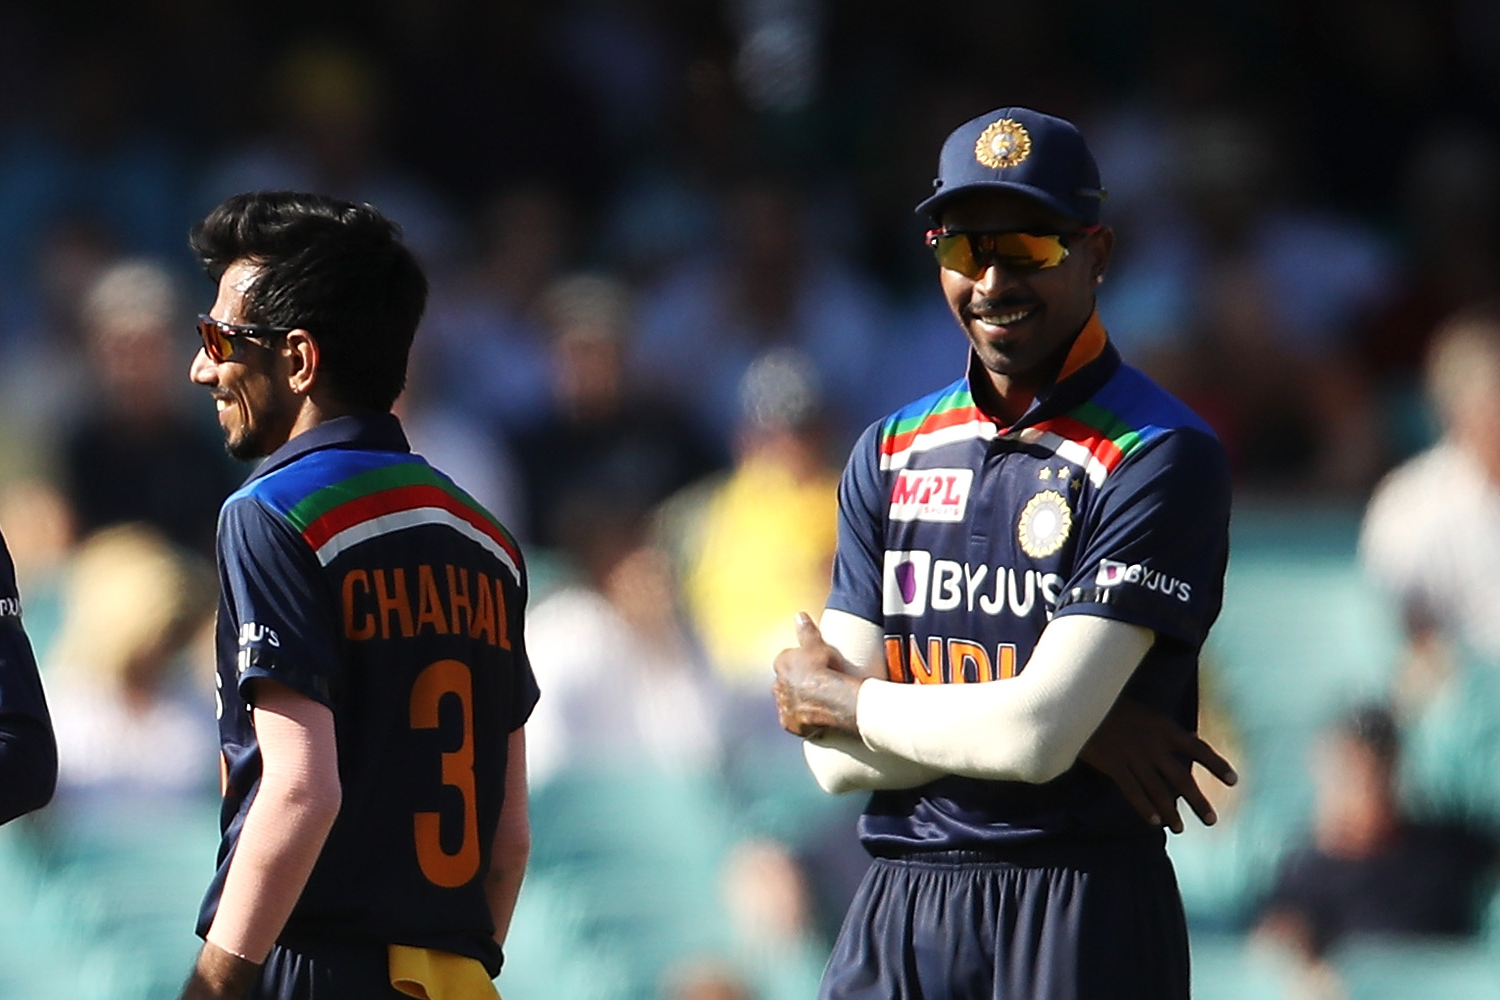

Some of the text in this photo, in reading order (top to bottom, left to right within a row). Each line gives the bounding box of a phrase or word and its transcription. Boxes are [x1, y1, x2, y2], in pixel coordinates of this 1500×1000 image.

[891, 475, 961, 505] MPL
[342, 564, 511, 651] CHAHAL
[931, 559, 1064, 619] BYJU'S
[1124, 564, 1192, 602] BYJU'S
[884, 634, 1017, 684] INDI
[410, 659, 481, 888] 3
